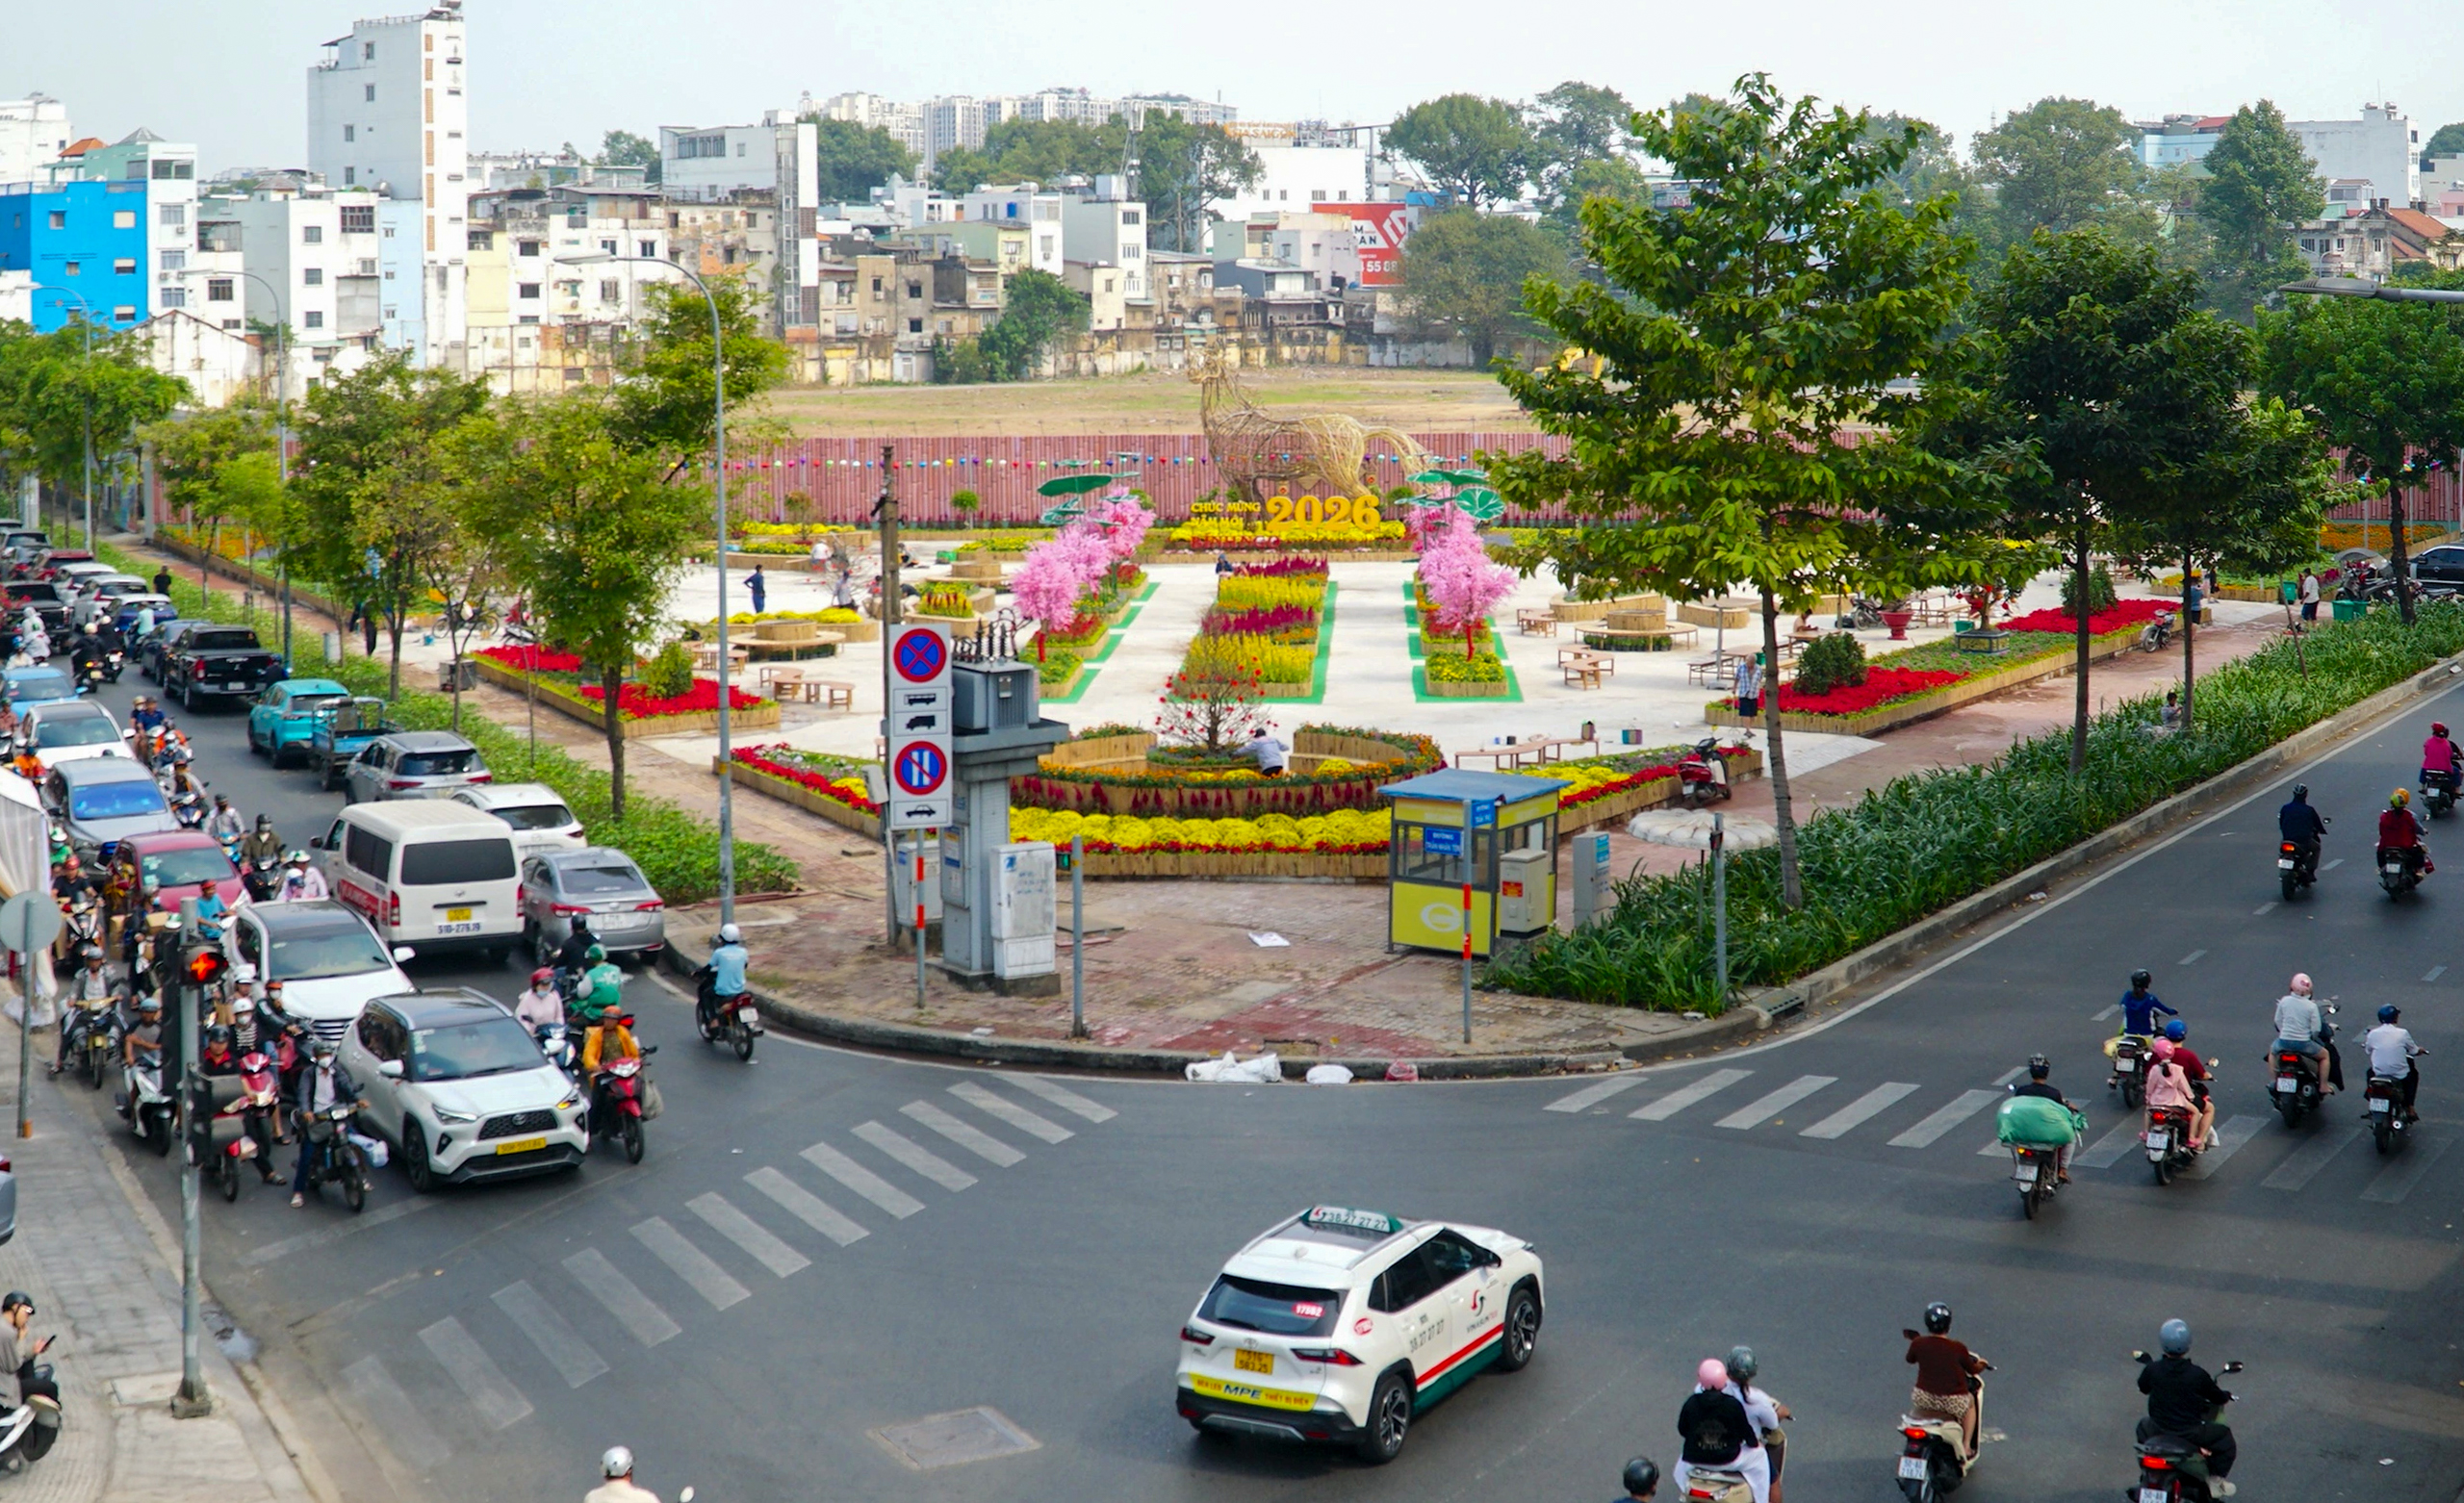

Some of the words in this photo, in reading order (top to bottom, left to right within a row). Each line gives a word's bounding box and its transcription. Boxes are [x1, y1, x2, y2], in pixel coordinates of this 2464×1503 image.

[1191, 499, 1223, 513] CHÚC
[1266, 495, 1380, 531] 2026
[1223, 1384, 1263, 1399] MPE
